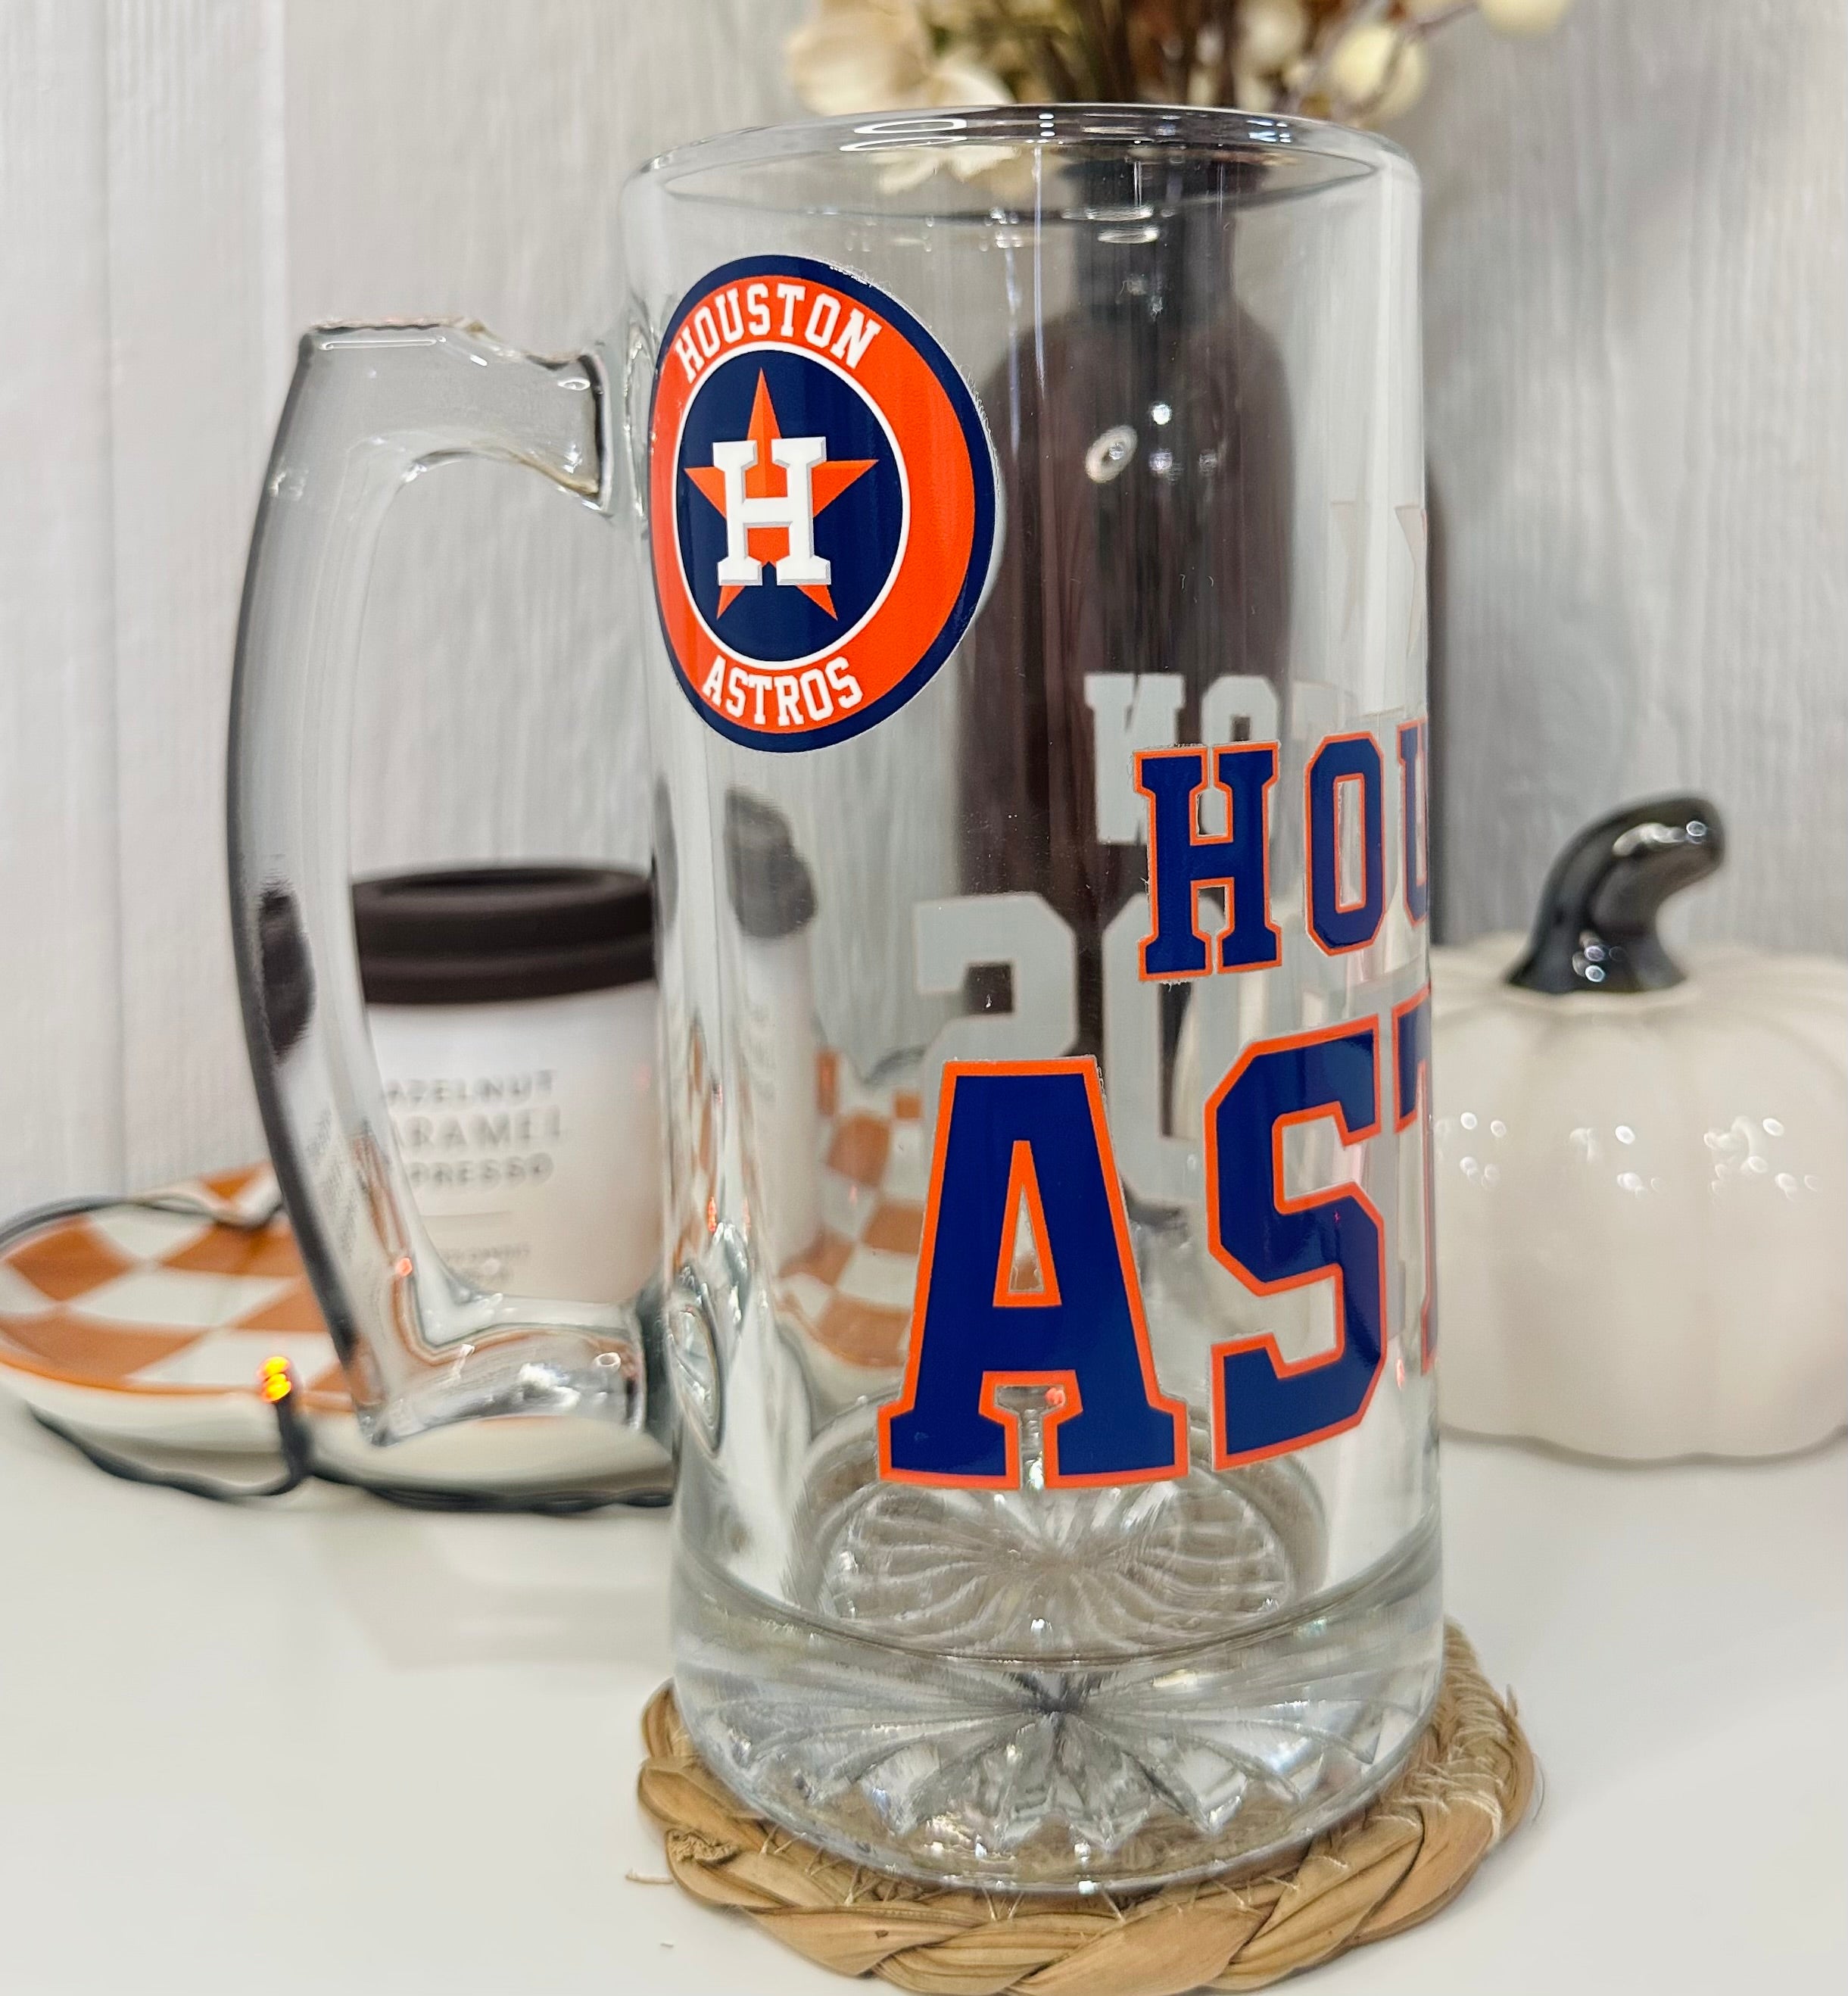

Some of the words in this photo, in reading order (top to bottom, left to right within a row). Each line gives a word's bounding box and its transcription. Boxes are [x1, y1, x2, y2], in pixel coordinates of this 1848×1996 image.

[675, 282, 882, 384] HOUSTON
[712, 435, 832, 587] H
[702, 655, 864, 728] ASTROS
